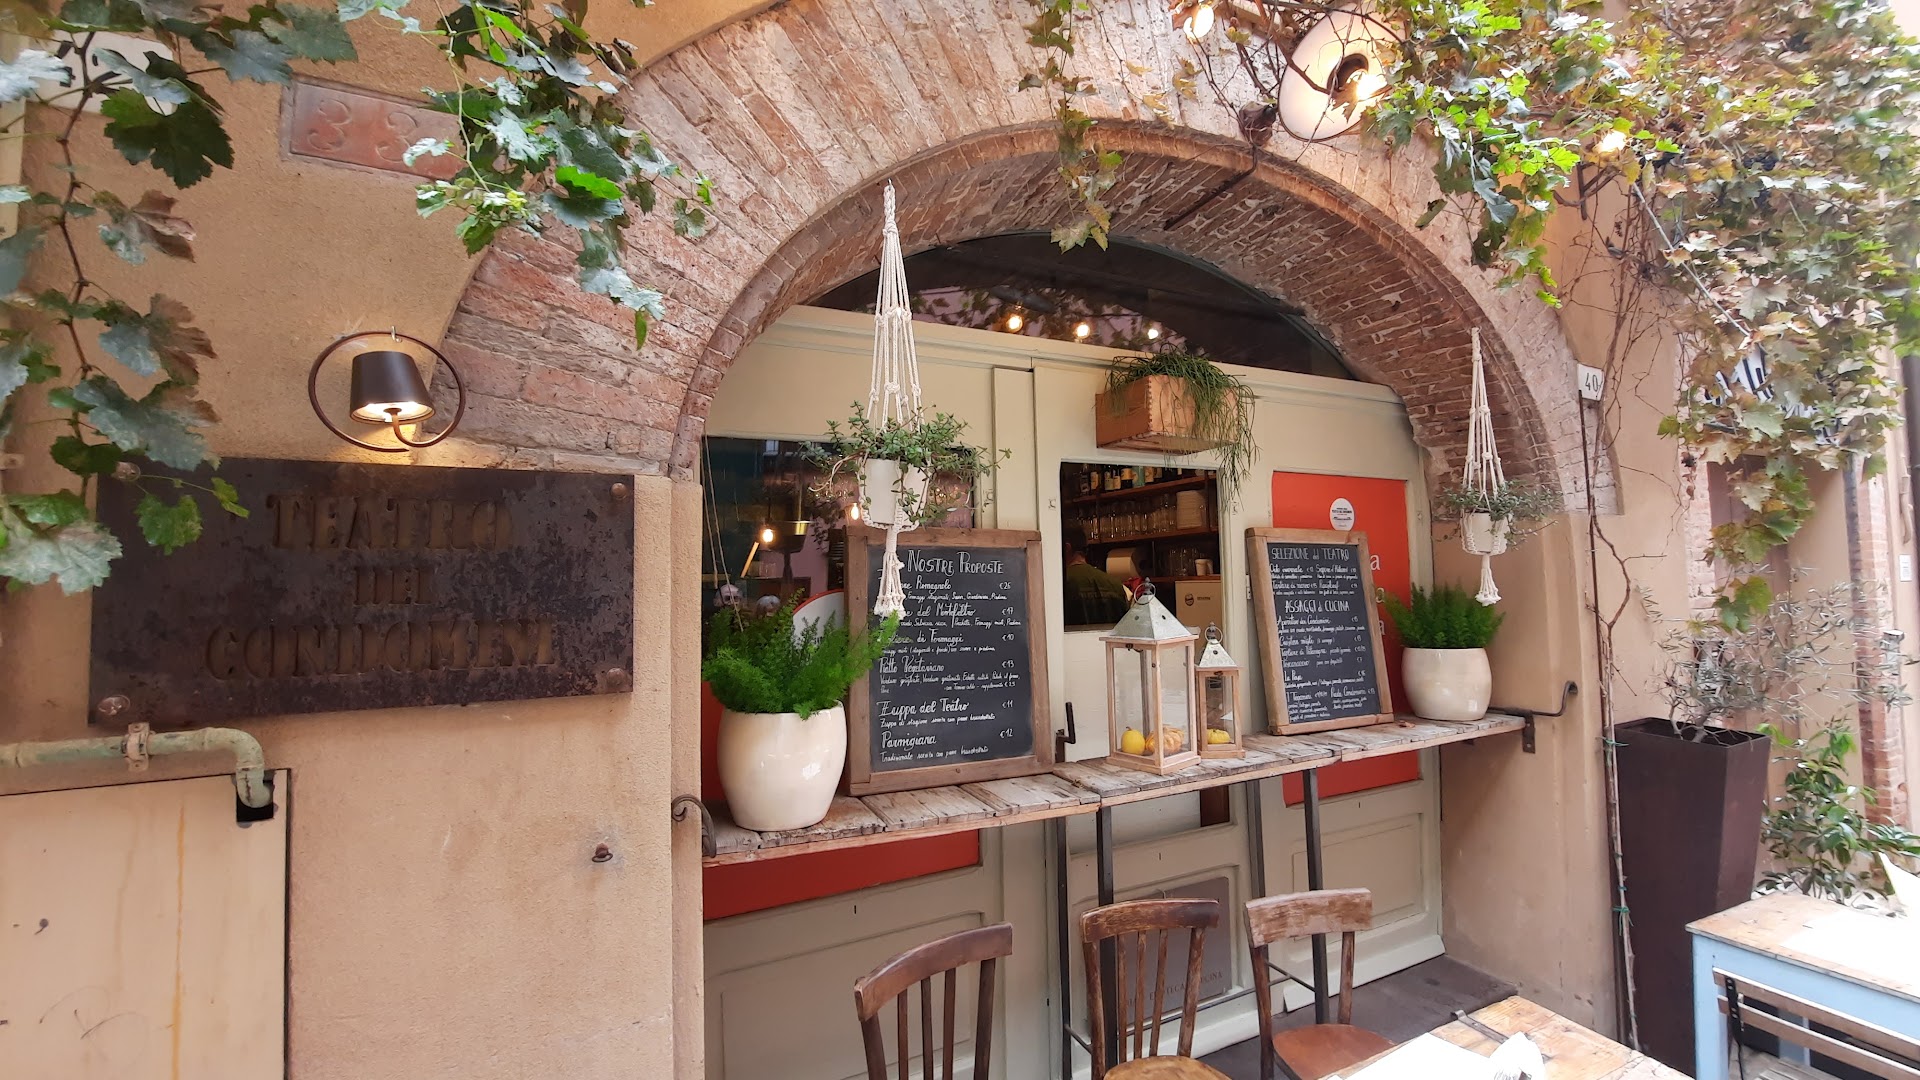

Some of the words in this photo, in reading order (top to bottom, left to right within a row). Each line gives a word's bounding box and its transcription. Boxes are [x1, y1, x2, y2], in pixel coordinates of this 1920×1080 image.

[1585, 373, 1599, 392] 40
[266, 494, 515, 551] TEATRO
[1322, 548, 1351, 561] TEATRO
[1284, 600, 1316, 614] ASSAGGI
[1324, 600, 1350, 613] CUCINA
[205, 613, 560, 682] CONDOMINI
[919, 701, 937, 714] del
[938, 697, 970, 712] Teatro
[881, 731, 938, 751] Parmigiana
